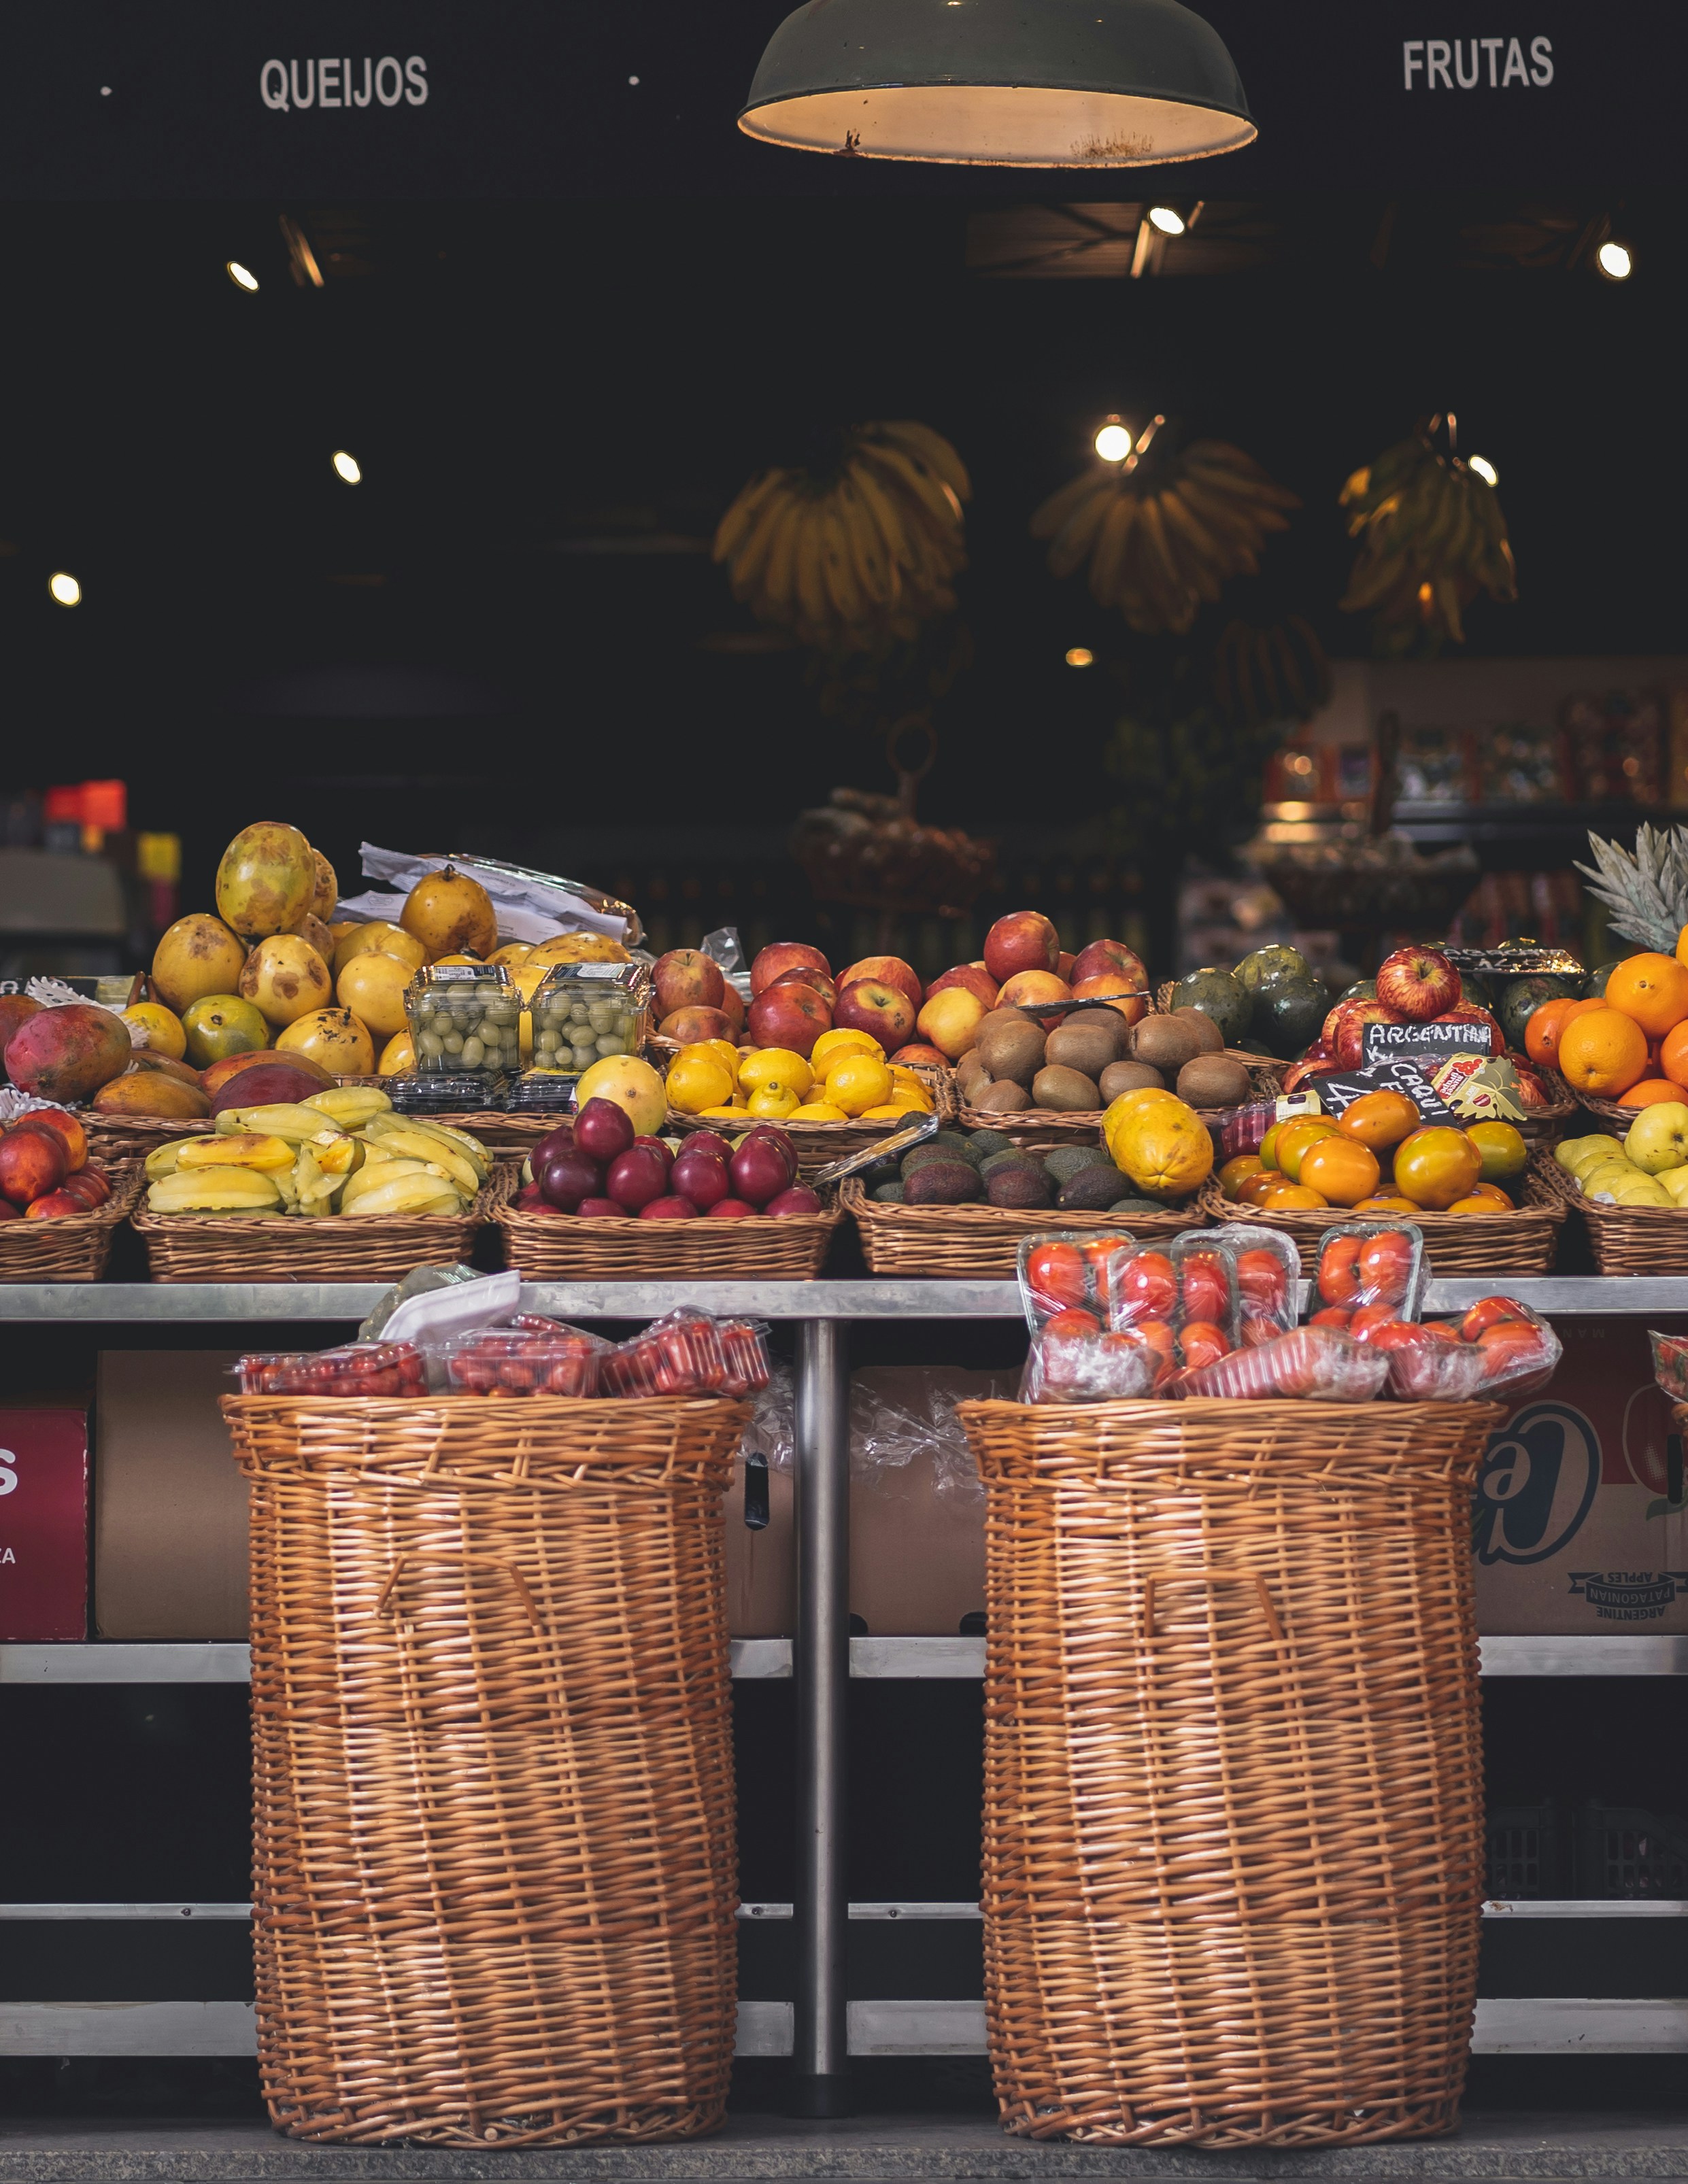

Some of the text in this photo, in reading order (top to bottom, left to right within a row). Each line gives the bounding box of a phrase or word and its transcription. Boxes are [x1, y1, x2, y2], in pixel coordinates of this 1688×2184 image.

[1403, 36, 1554, 90] FRUTAS
[260, 56, 428, 112] QUEIJOS
[1391, 1063, 1449, 1115] CAQUI
[1440, 1072, 1459, 1093] grape
[1445, 1075, 1464, 1096] sweet
[1562, 1328, 1605, 1338] MAN
[1469, 1412, 1590, 1557] Ce
[1608, 1572, 1653, 1583] APPLES
[1590, 1588, 1670, 1604] PATAGONIAN
[1596, 1605, 1666, 1620] ARGENTINE
